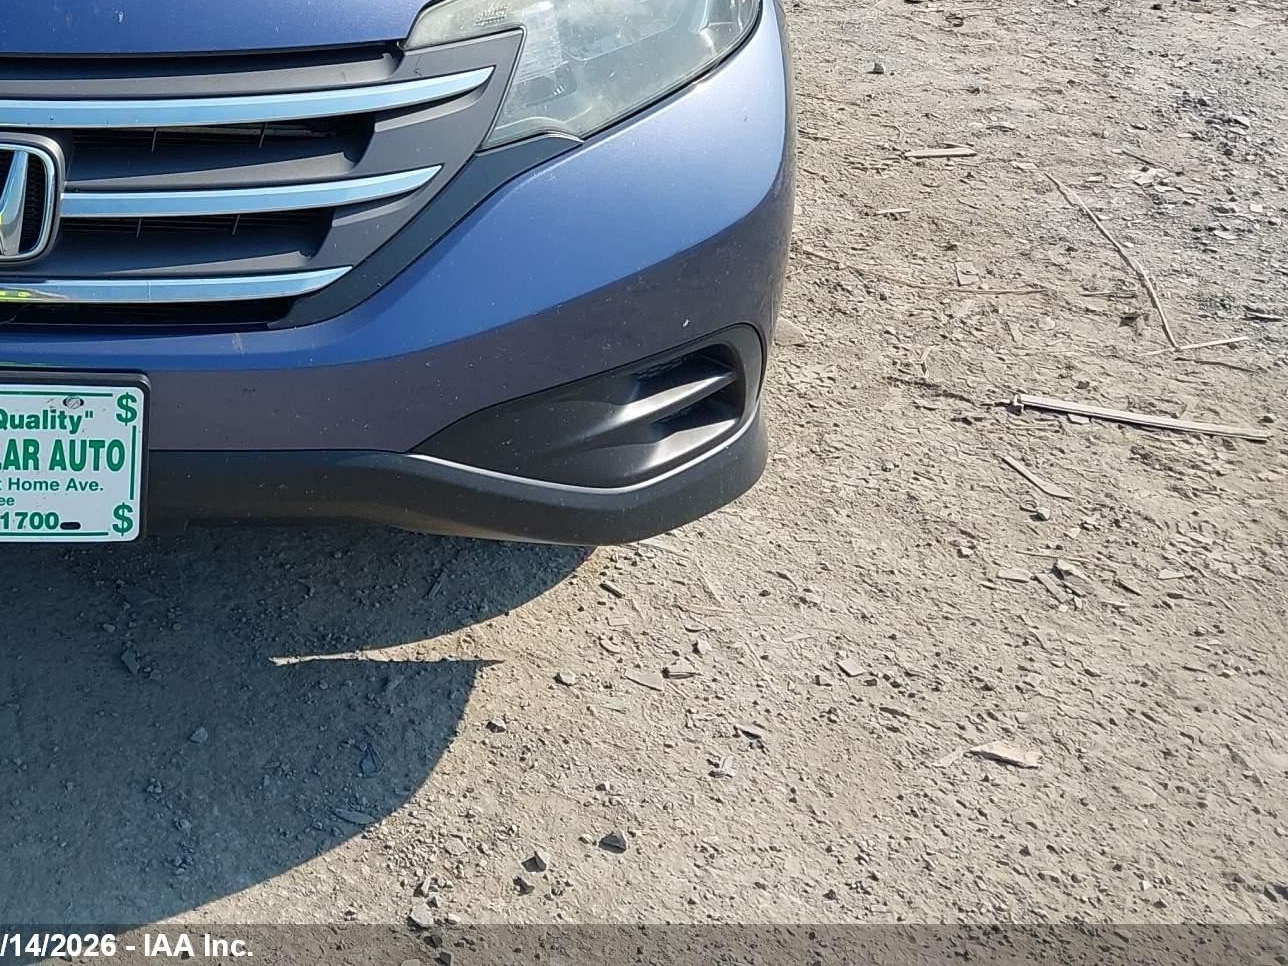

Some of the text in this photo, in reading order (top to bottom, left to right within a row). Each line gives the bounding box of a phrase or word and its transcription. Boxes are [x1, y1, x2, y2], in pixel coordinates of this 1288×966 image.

[116, 393, 137, 425] $
[49, 439, 125, 472] AUTO
[8, 477, 59, 492] Home
[67, 477, 104, 492] Ave.
[112, 502, 134, 537] $
